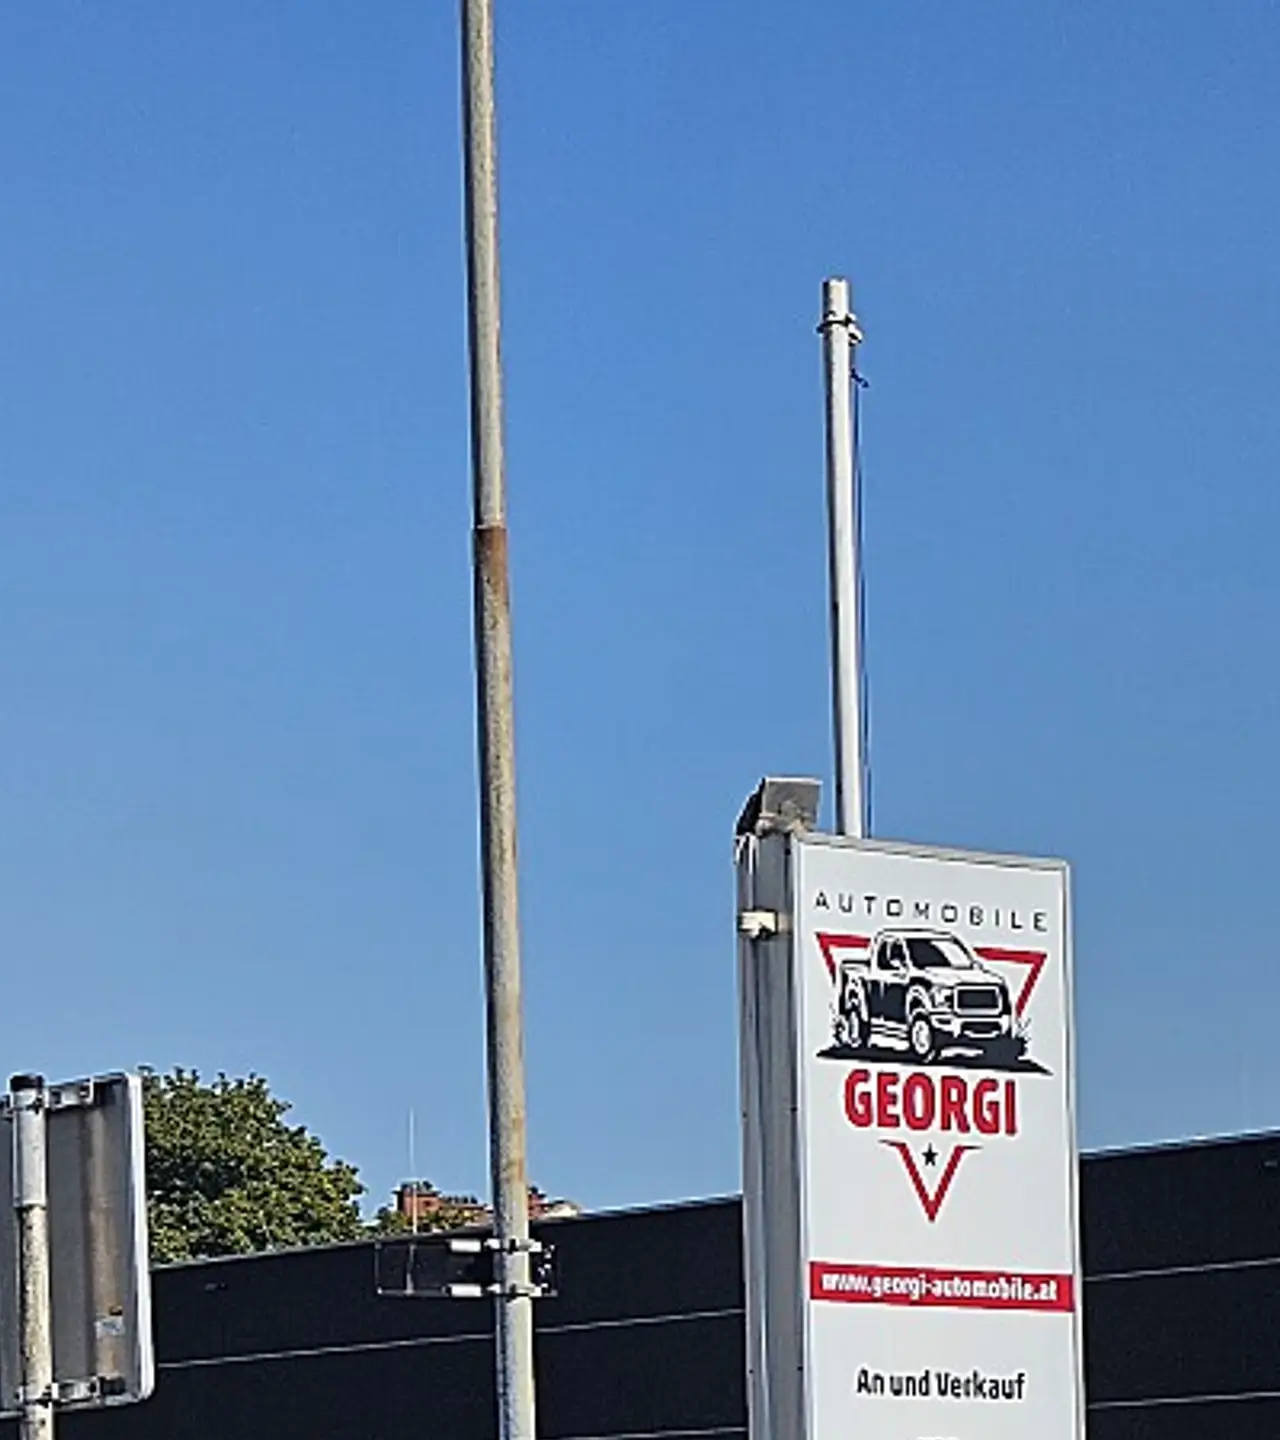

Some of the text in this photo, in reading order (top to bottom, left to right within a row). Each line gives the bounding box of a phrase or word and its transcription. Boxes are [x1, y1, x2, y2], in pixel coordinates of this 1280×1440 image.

[815, 890, 1048, 933] AUTOMOBILE
[844, 1068, 1017, 1136] GEORGI
[821, 1272, 1059, 1302] www.georgi-automobile.at
[856, 1368, 1026, 1400] An und Verkauf
